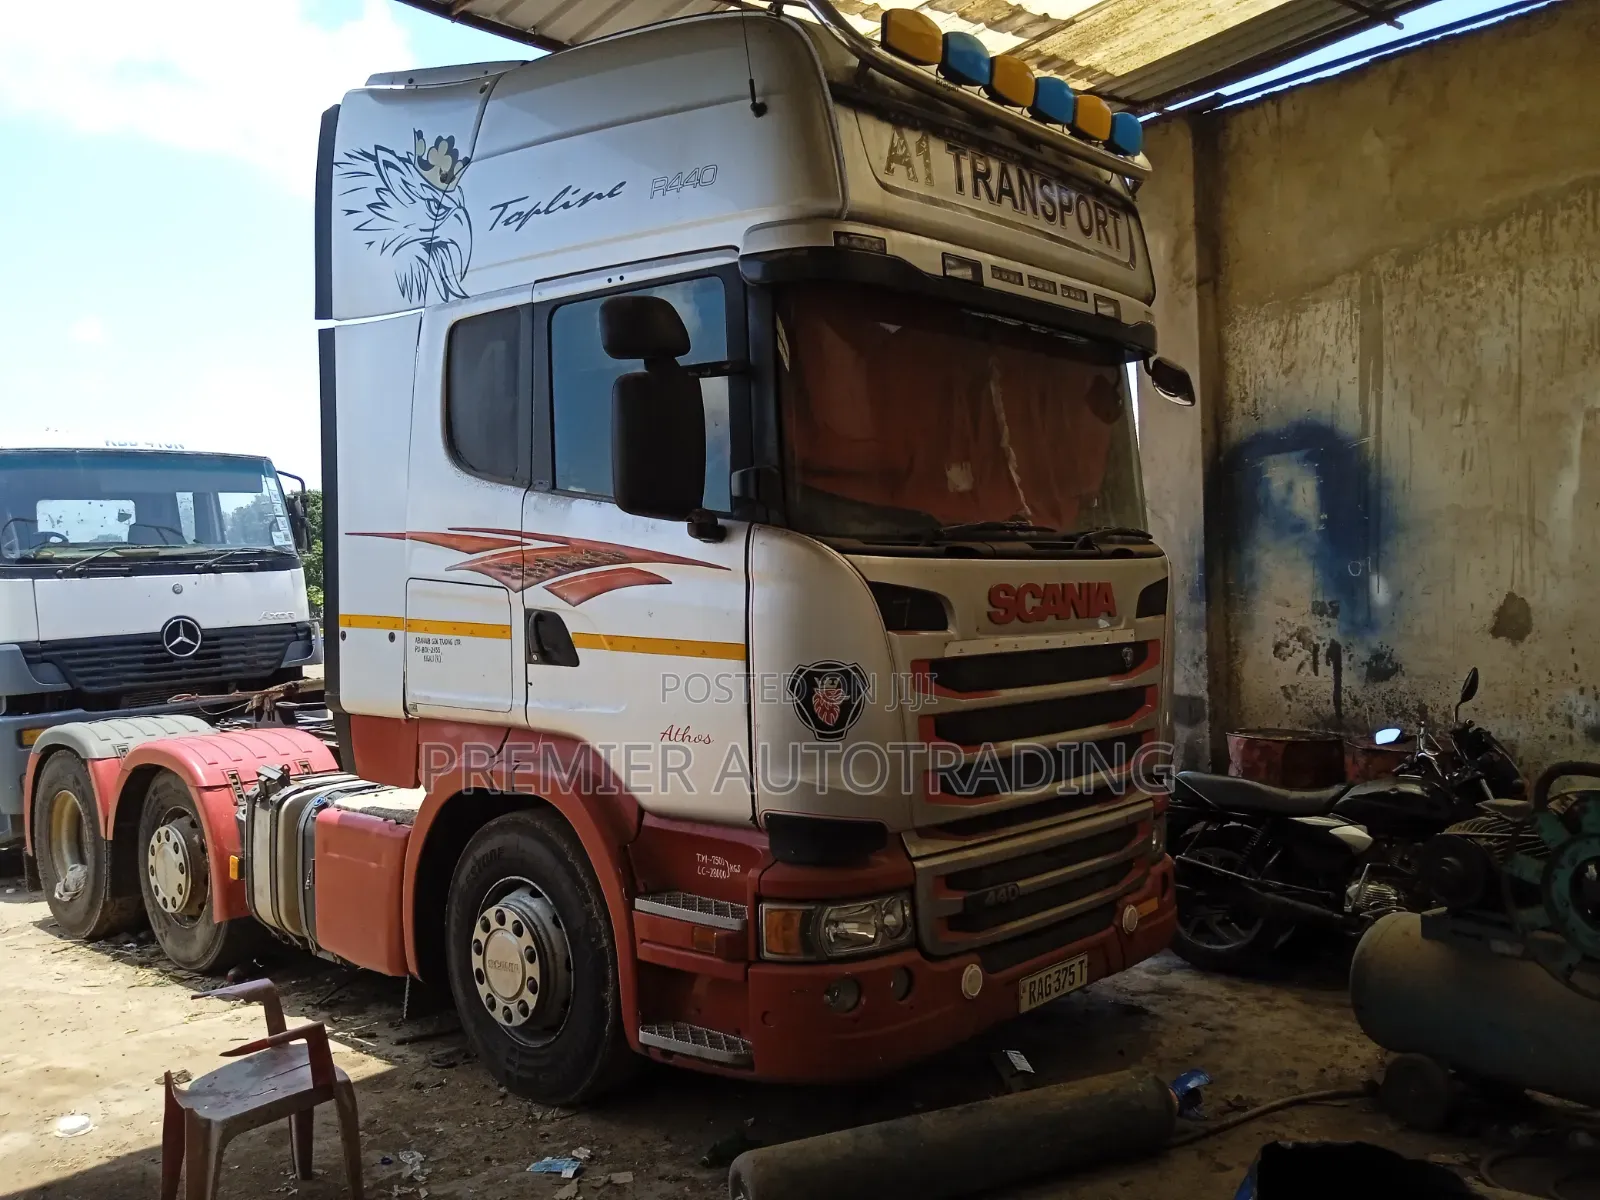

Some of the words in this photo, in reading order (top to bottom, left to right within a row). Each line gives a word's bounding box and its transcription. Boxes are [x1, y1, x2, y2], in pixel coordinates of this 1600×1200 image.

[488, 181, 627, 232] Topline
[650, 164, 718, 200] R440
[883, 125, 935, 187] A1
[944, 141, 1122, 251] TRANSPORT
[986, 582, 1118, 625] SCANIA
[660, 723, 715, 745] Athos
[1029, 973, 1052, 1006] RAG
[1053, 963, 1076, 993] 375
[1078, 959, 1085, 984] T
